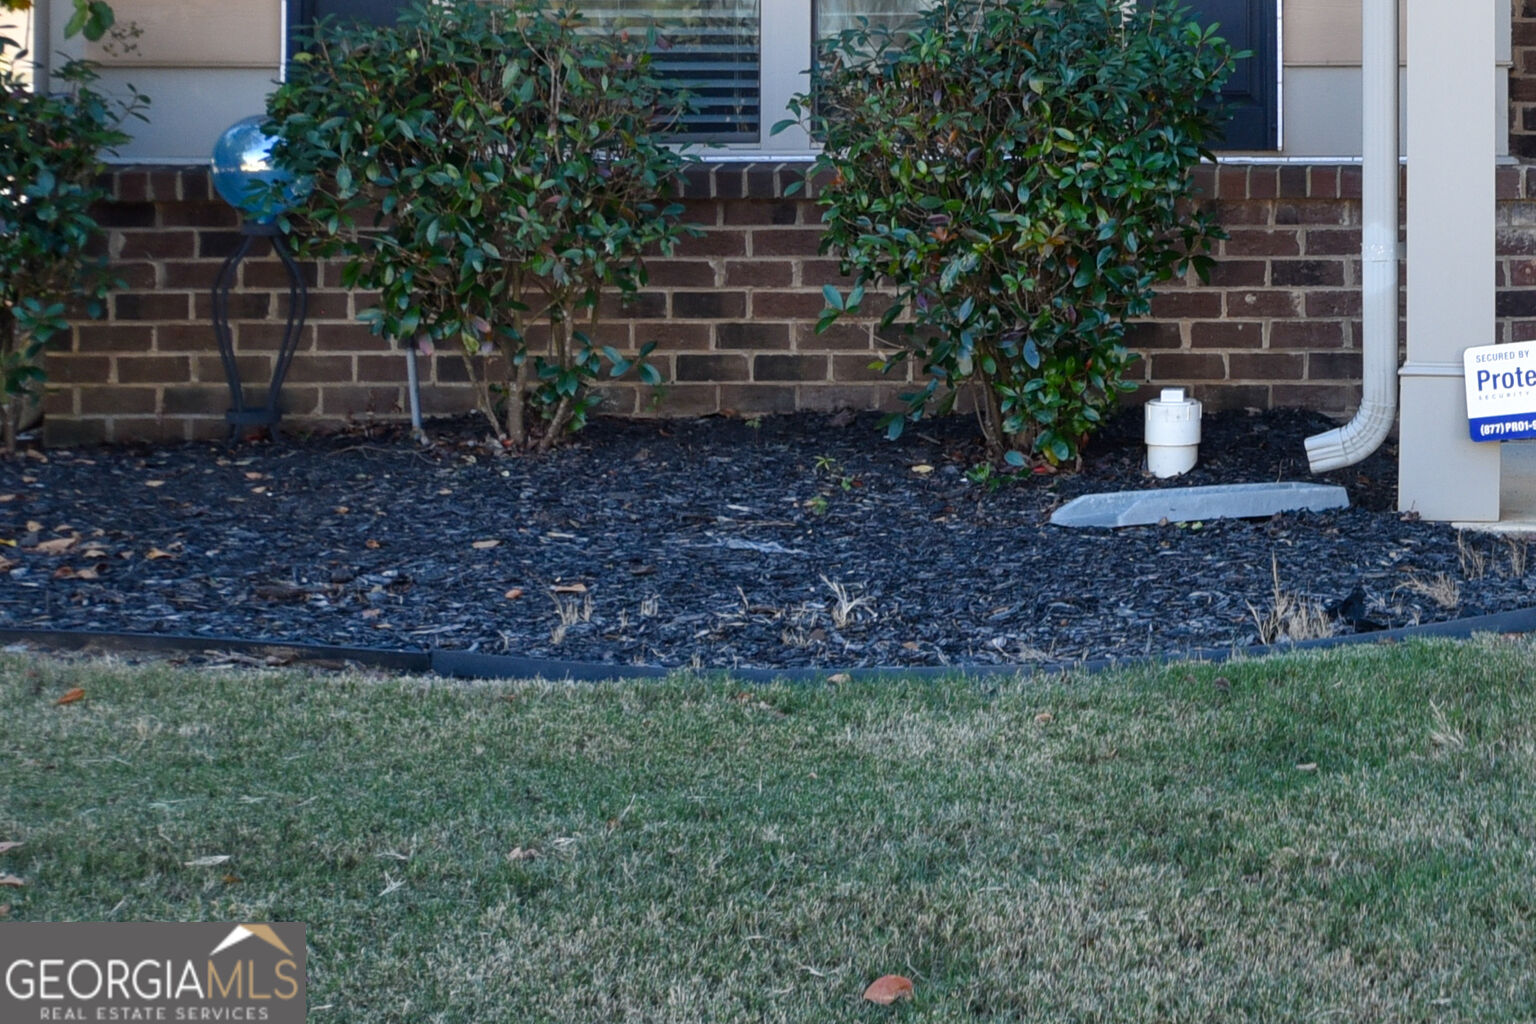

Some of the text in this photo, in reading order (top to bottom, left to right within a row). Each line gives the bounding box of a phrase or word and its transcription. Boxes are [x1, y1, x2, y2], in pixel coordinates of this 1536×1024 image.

[1476, 350, 1530, 363] SECURED BY
[1478, 391, 1530, 401] SECURITY
[1480, 423, 1504, 436] (877)
